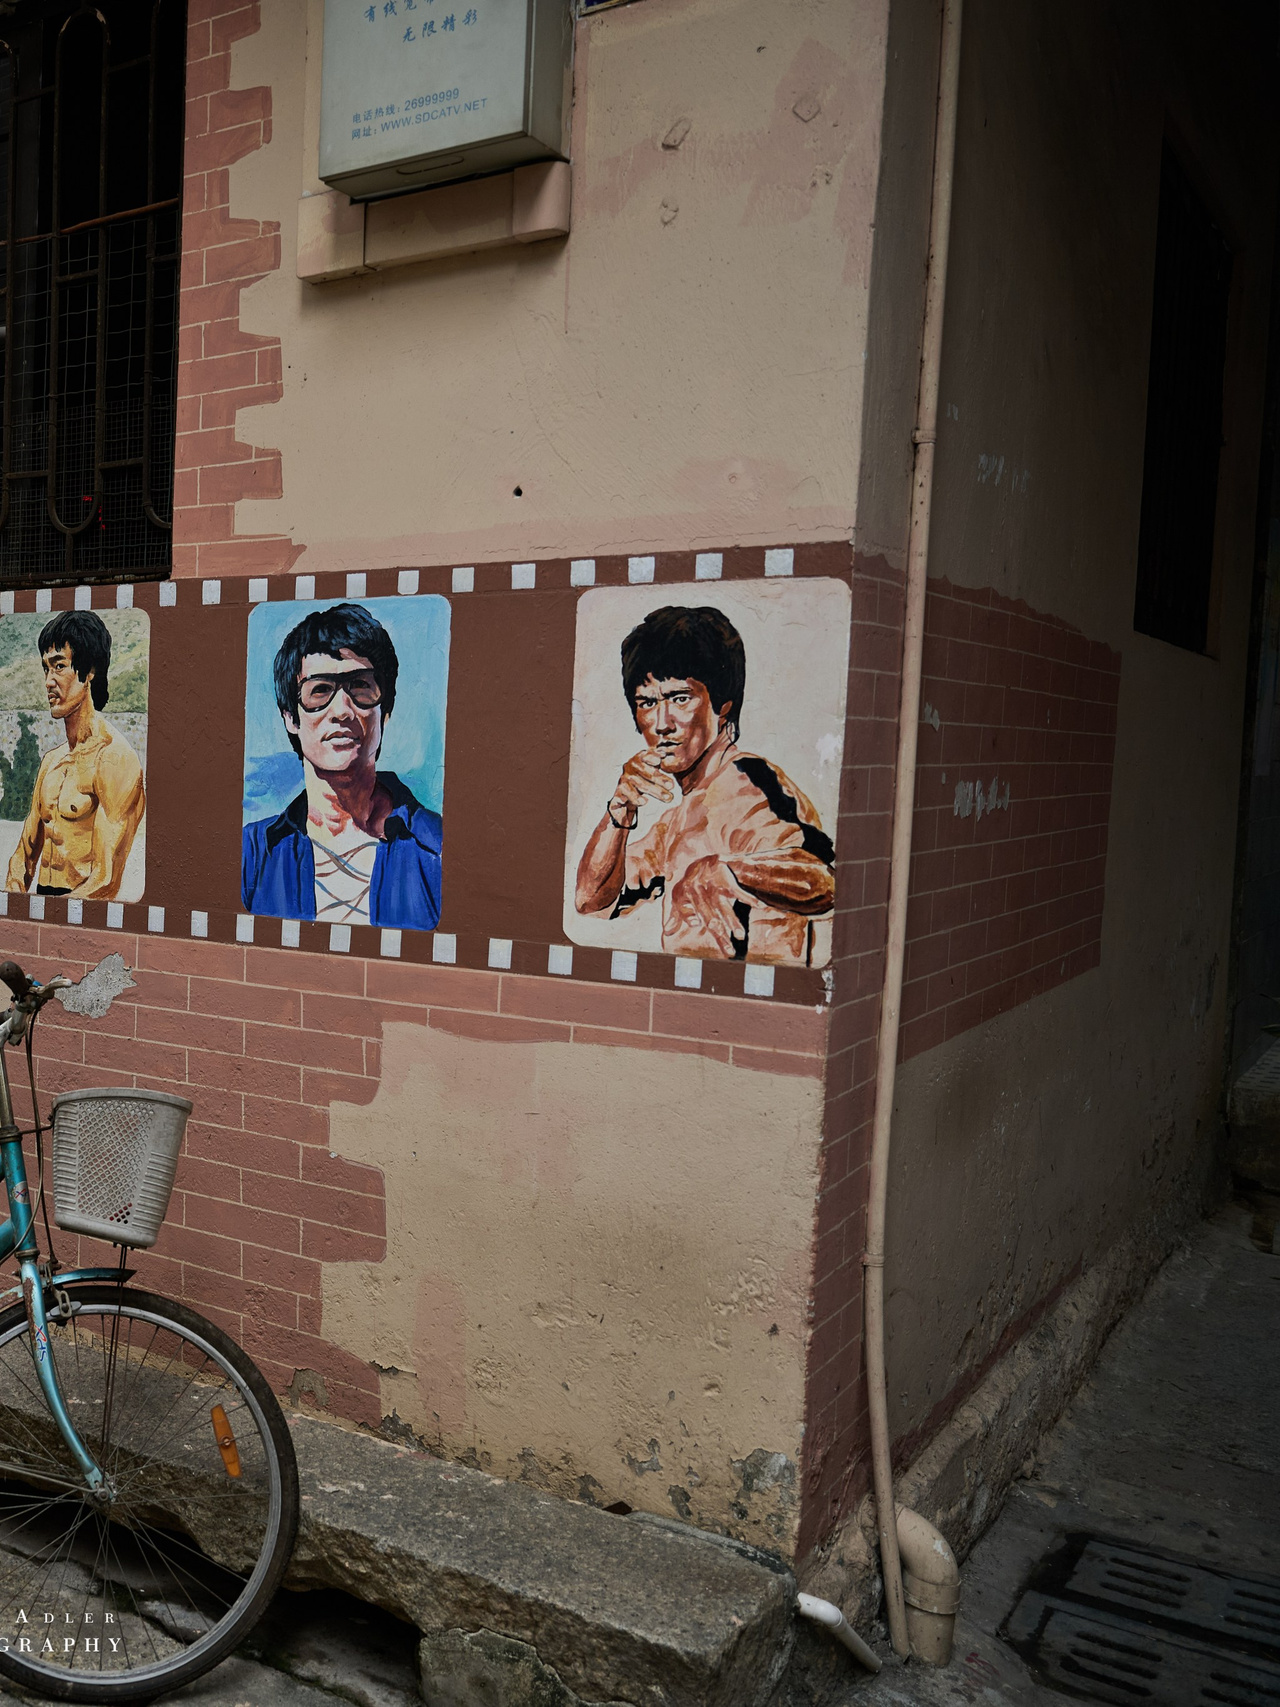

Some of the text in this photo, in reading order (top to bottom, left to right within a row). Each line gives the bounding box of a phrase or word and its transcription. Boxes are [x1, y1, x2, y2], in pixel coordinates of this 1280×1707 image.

[402, 9, 478, 43] 无限精彩
[380, 98, 488, 133] WWW.SDCATV.NET
[404, 88, 460, 112] 26999999
